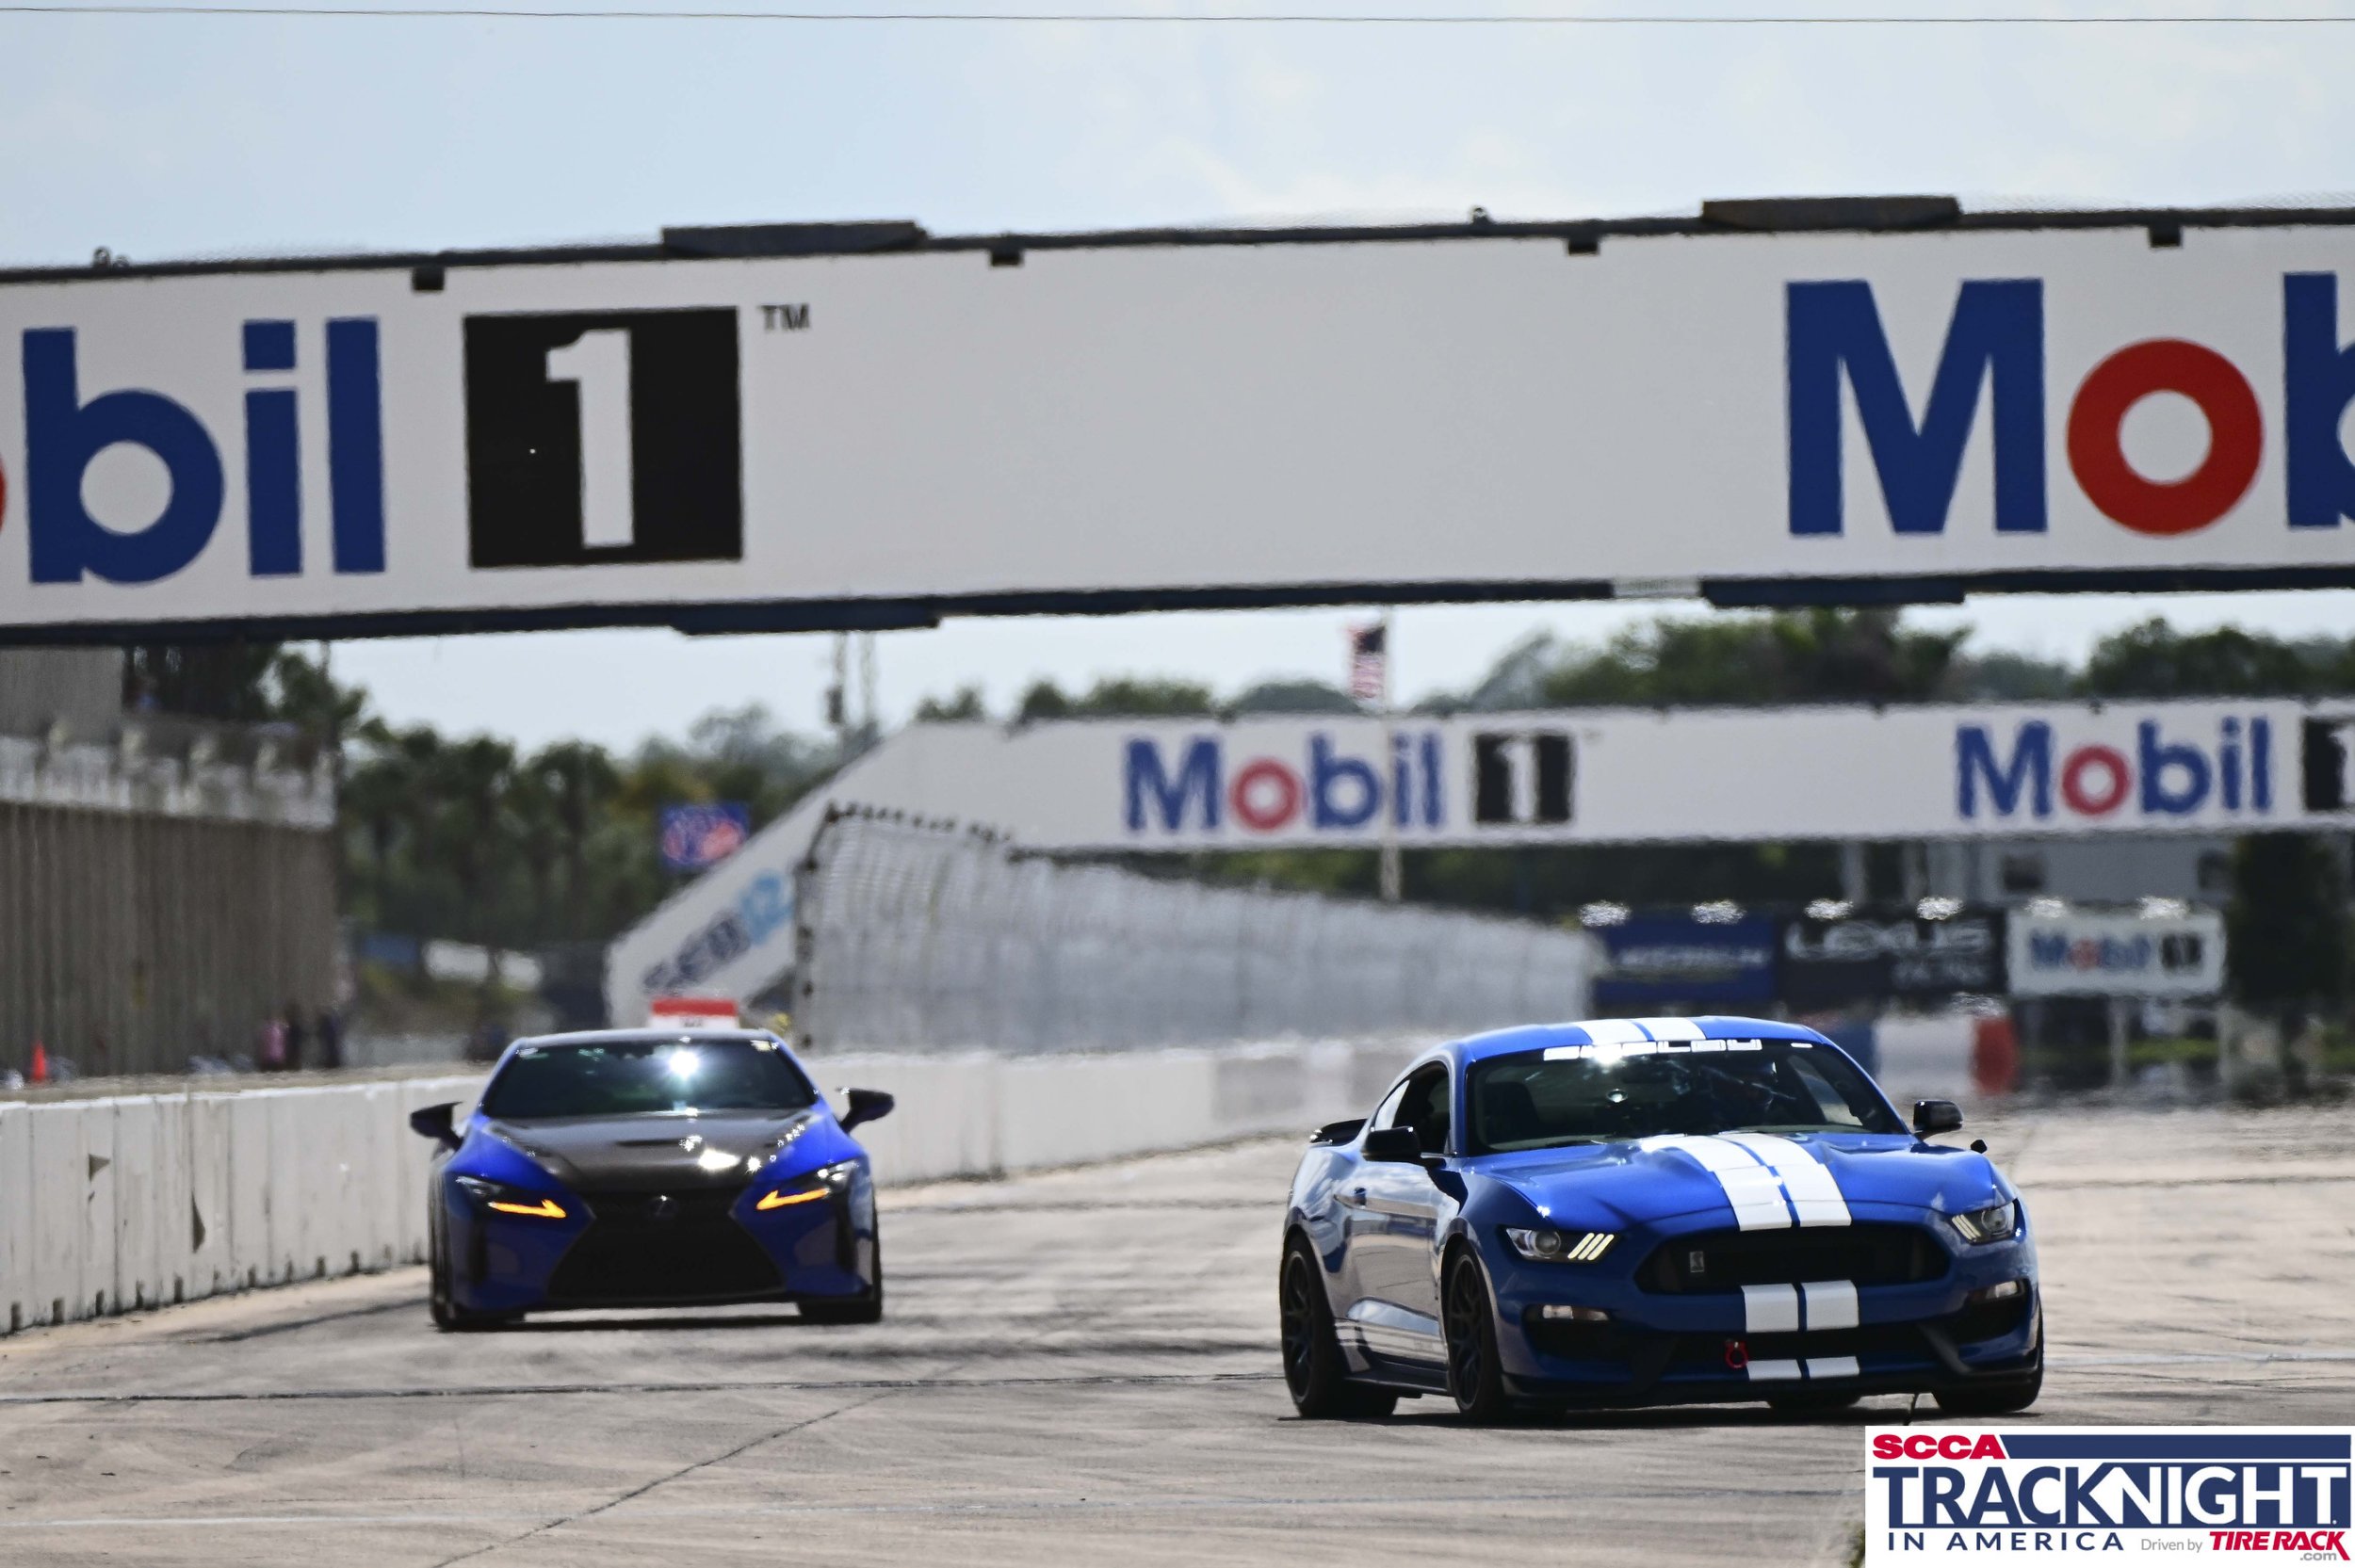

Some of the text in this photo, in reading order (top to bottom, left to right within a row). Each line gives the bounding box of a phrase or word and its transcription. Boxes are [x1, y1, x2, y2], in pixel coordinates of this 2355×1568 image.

[0, 315, 386, 586] bil
[544, 327, 634, 550] 1
[1124, 731, 1443, 832] Mobil
[1956, 715, 2271, 818] Mobil
